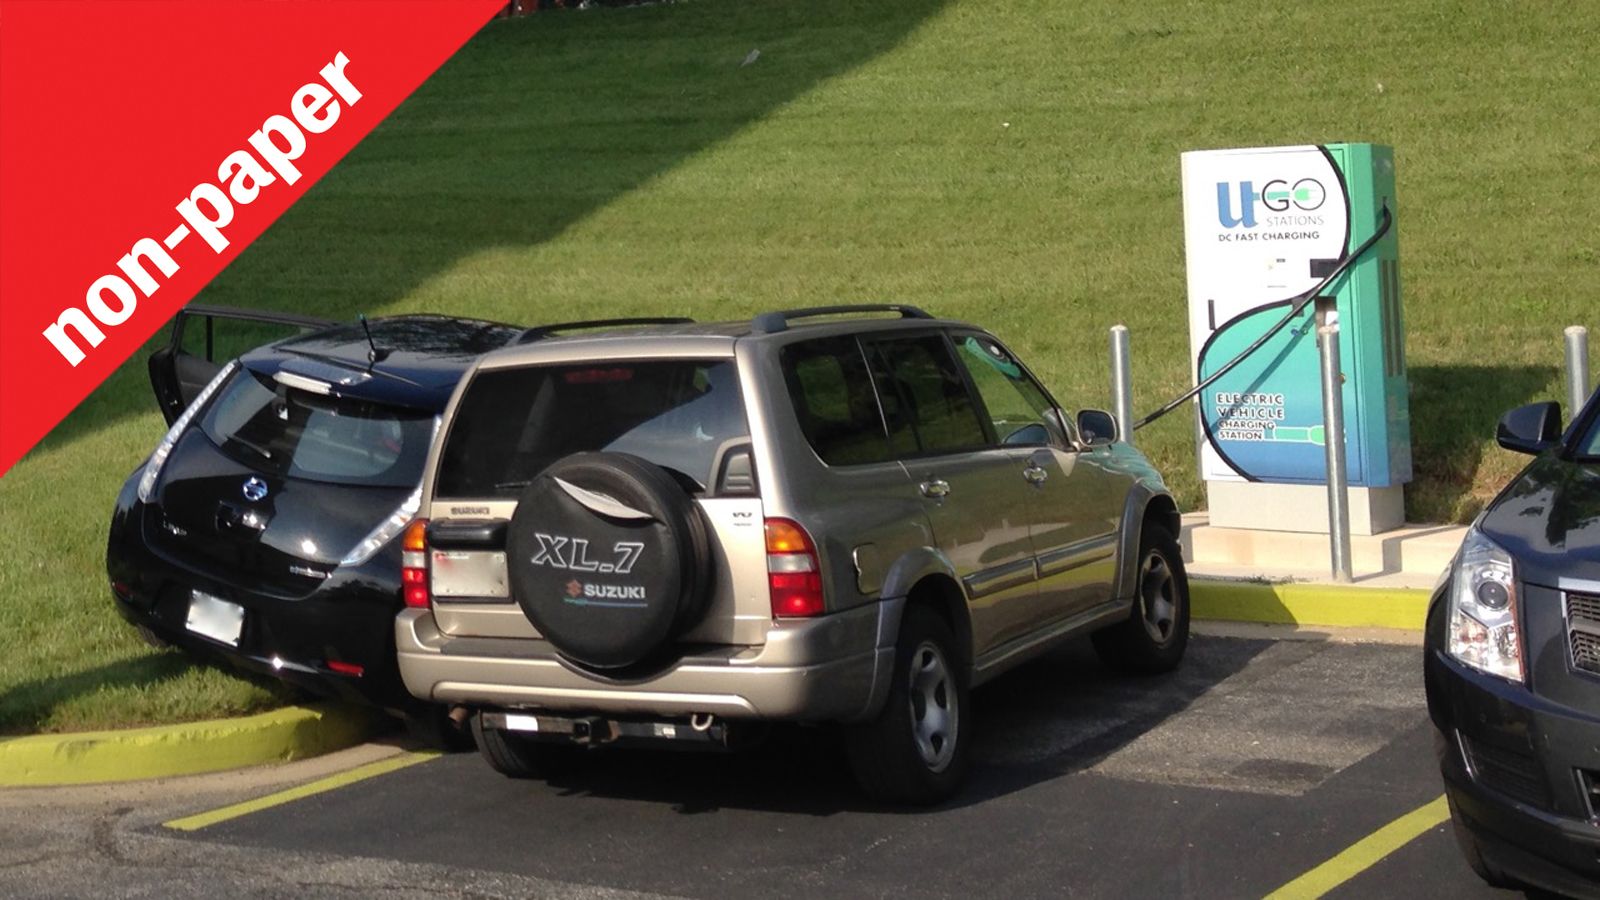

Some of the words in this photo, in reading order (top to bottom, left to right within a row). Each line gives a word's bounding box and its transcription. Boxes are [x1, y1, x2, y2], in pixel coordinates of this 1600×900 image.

[1266, 215, 1325, 227] STATIONS
[1218, 233, 1232, 242] DC
[1235, 232, 1259, 241] FAST
[1261, 230, 1320, 241] CHARGING
[1216, 393, 1285, 405] ELECTRIC
[1217, 407, 1285, 419] VEHICLE
[1218, 420, 1276, 430] CHARGING
[1218, 431, 1263, 440] STATION
[584, 584, 647, 599] SUZUKI
